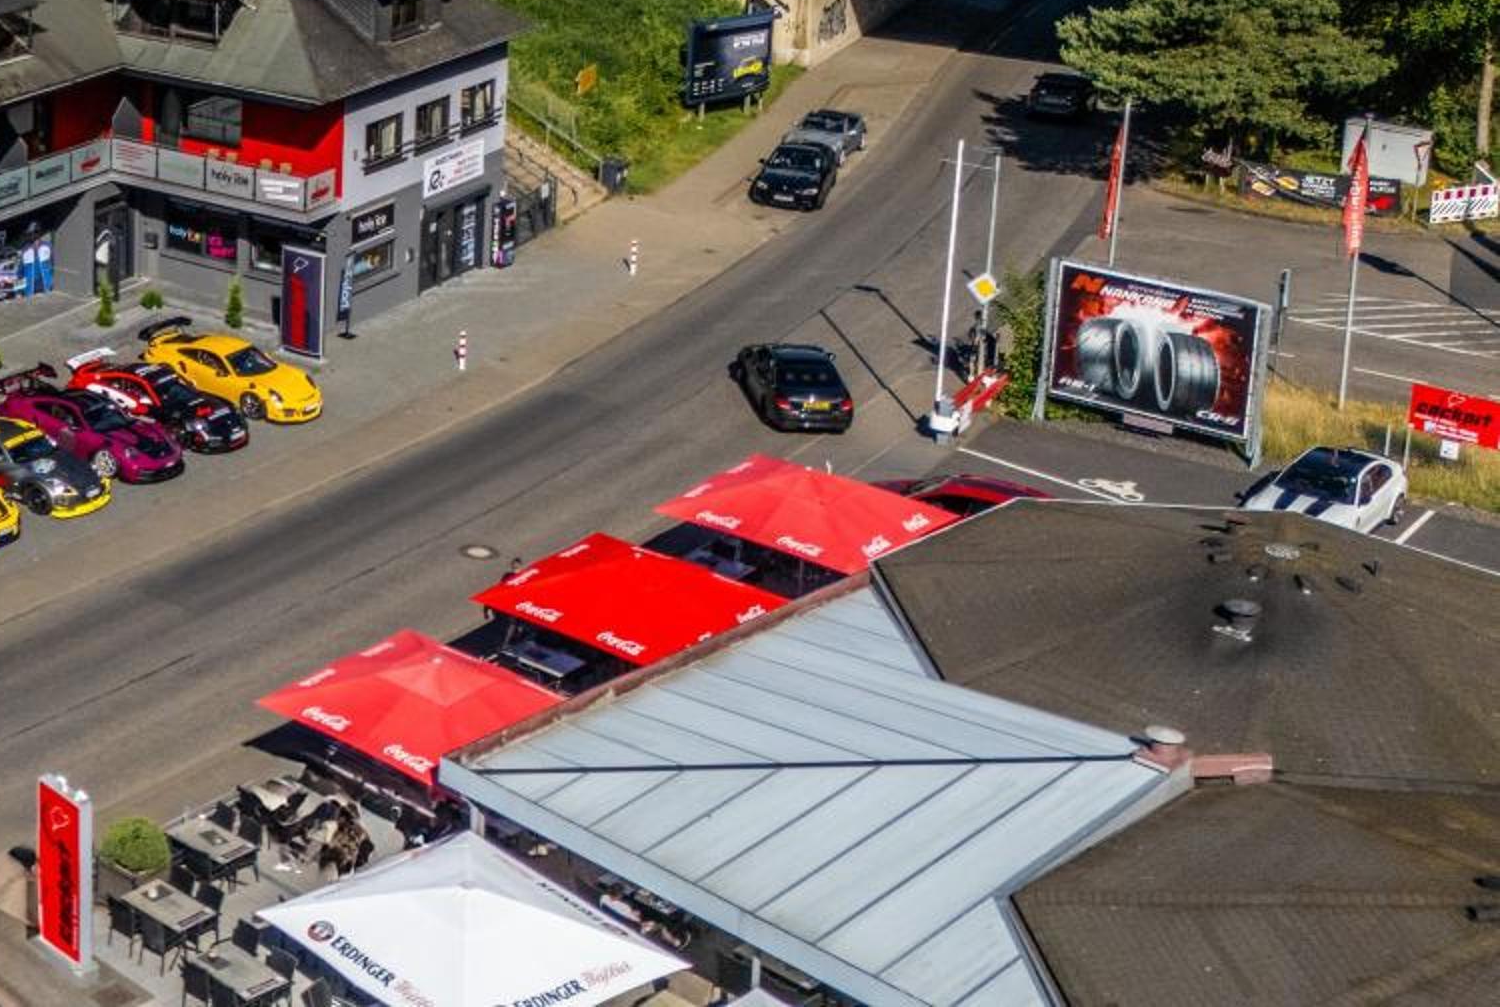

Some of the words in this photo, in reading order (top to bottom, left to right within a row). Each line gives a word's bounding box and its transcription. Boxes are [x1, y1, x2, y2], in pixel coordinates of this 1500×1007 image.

[1100, 285, 1176, 308] NANKANG
[776, 535, 824, 557] Coca-Cola
[515, 600, 564, 623] Coca-Cola
[596, 630, 646, 656] Coca-Cola
[301, 705, 351, 731] Coca-Cola
[383, 743, 433, 773] Coca-Cola
[329, 934, 396, 989] ERDINGER
